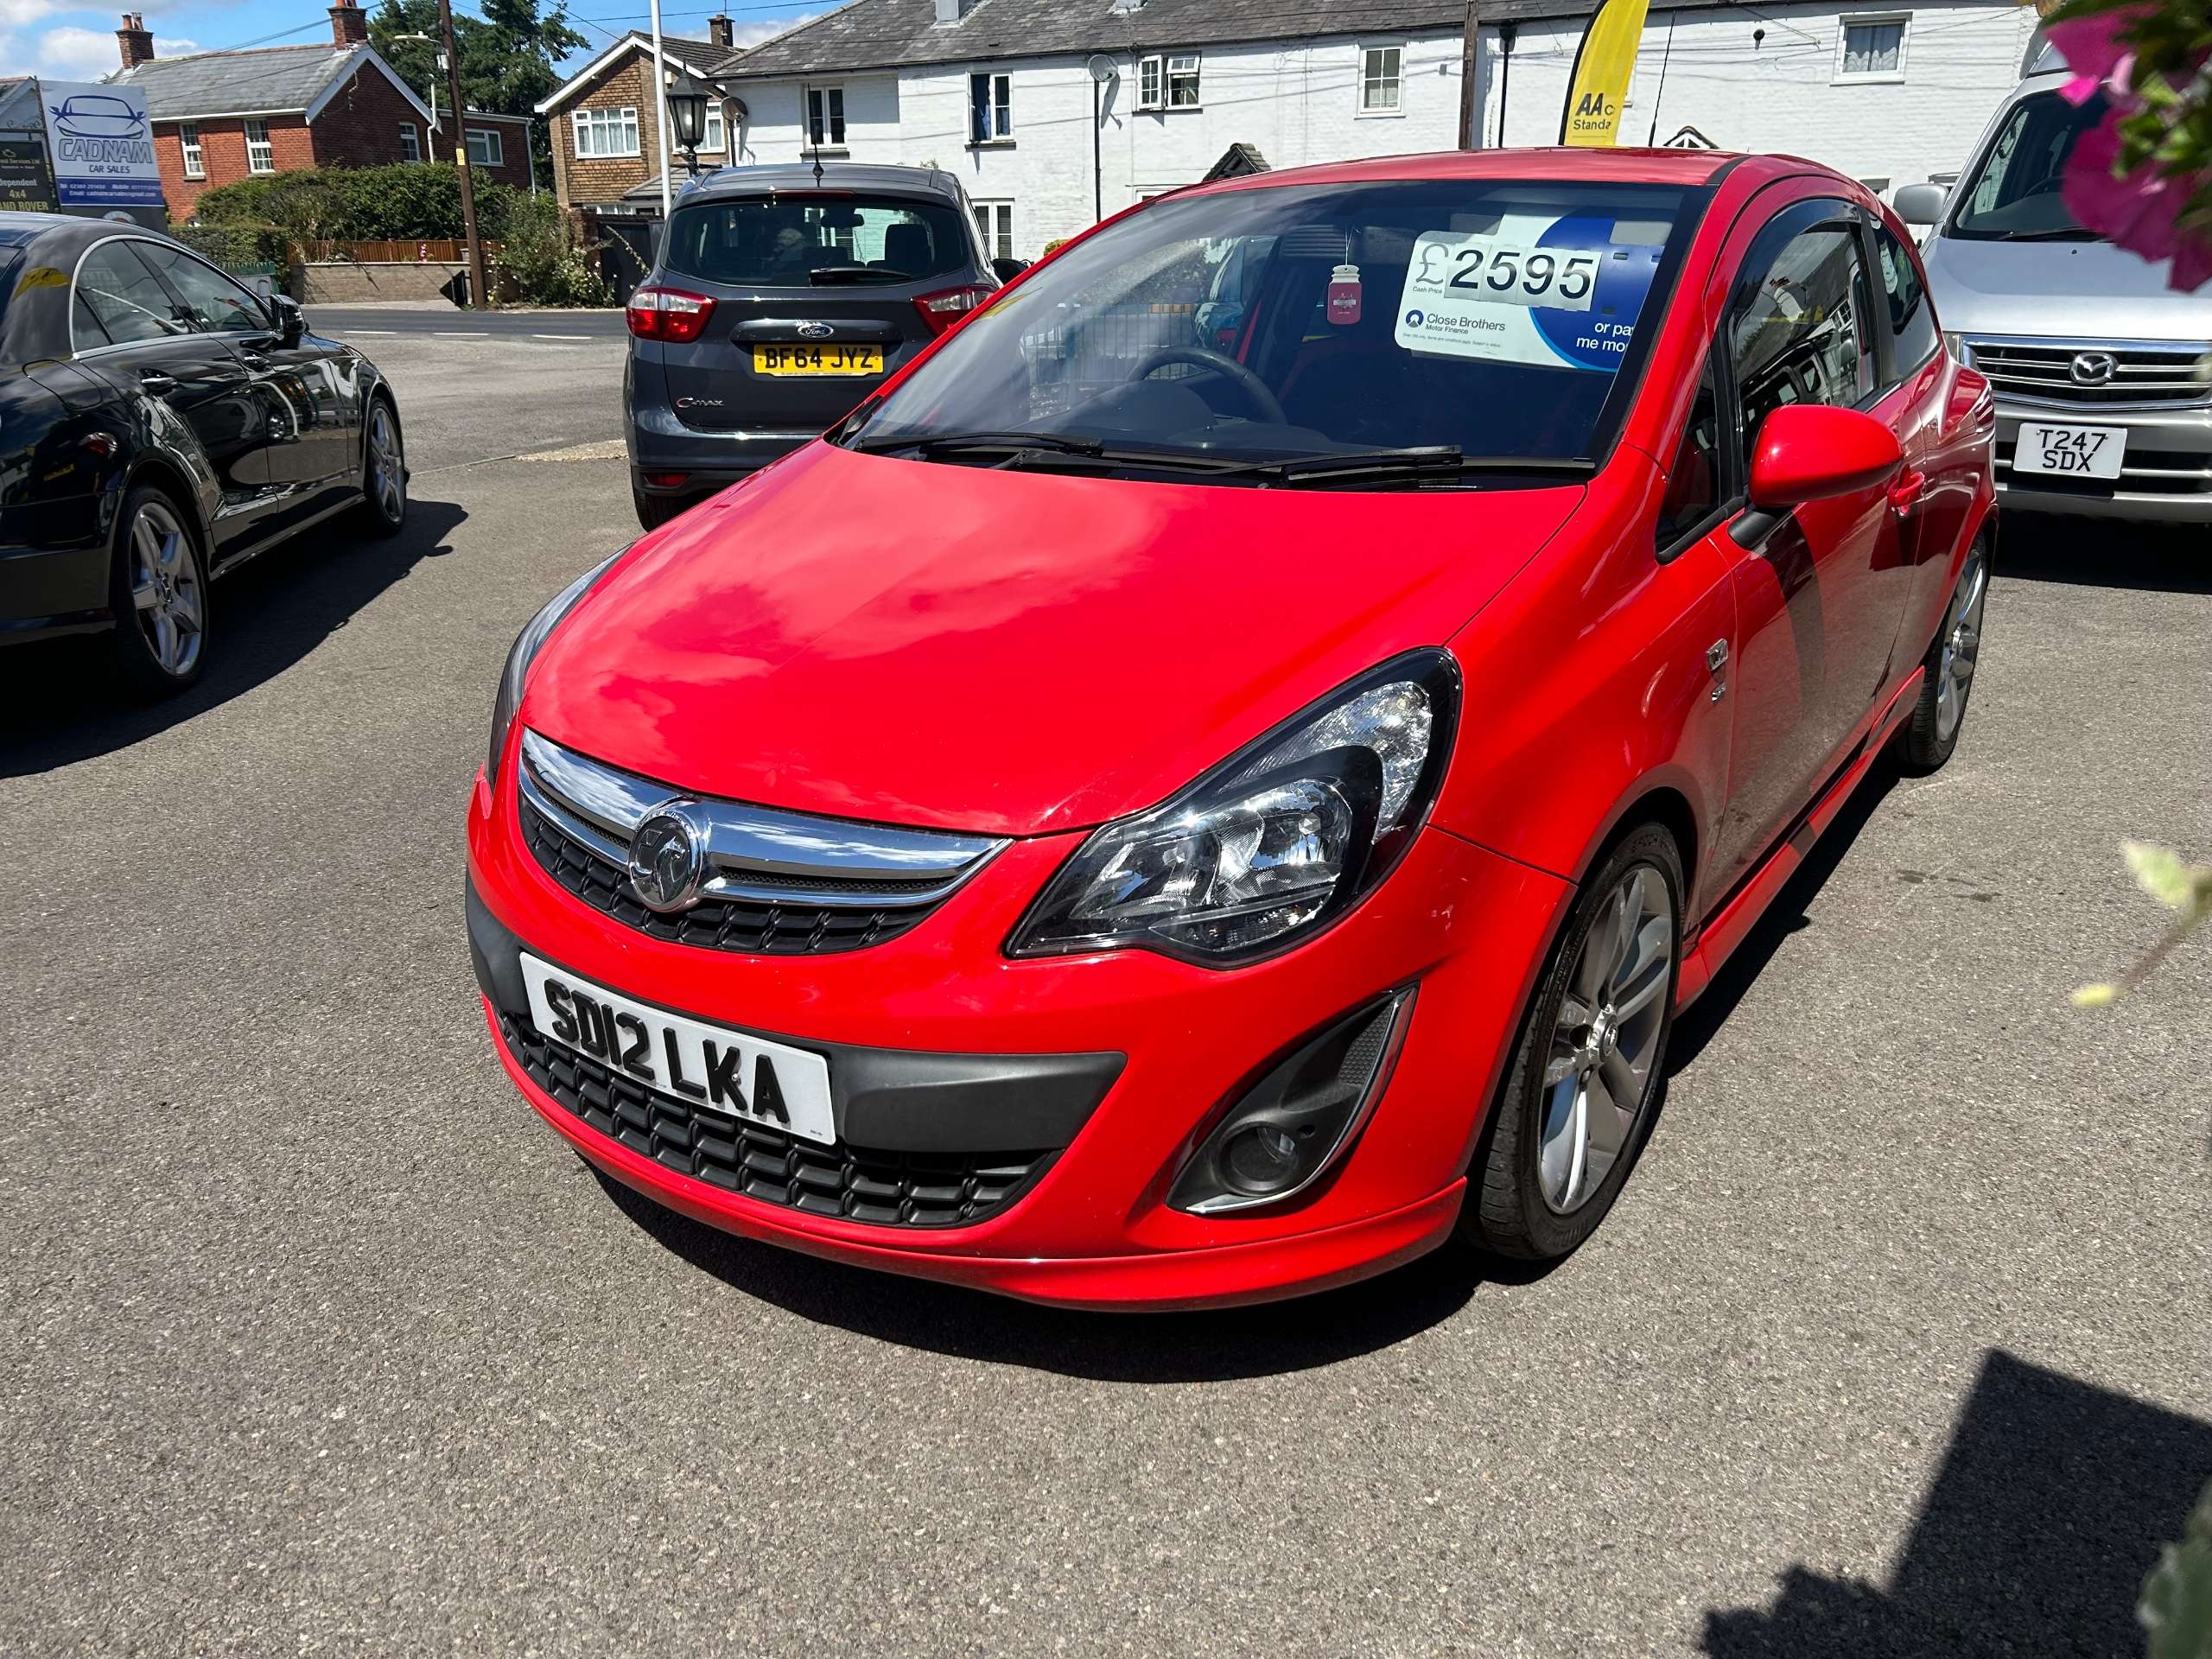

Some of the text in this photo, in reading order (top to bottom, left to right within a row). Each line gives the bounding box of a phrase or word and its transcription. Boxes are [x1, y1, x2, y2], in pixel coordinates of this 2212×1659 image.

[1575, 92, 1604, 116] AA
[58, 138, 153, 163] CADNAM
[89, 164, 130, 174] CAR SALES
[17, 200, 49, 212] ROVER
[1414, 243, 1593, 300] £2595
[804, 326, 827, 336] Ford
[1427, 313, 1506, 332] Close Brothers
[1445, 326, 1469, 334] Finance
[1594, 322, 1611, 334] or
[1576, 337, 1628, 353] me mo
[765, 347, 874, 369] BF64 JYZ
[2039, 429, 2107, 452] T247
[2042, 449, 2094, 472] SDX
[543, 977, 791, 1124] SD12 LKA
